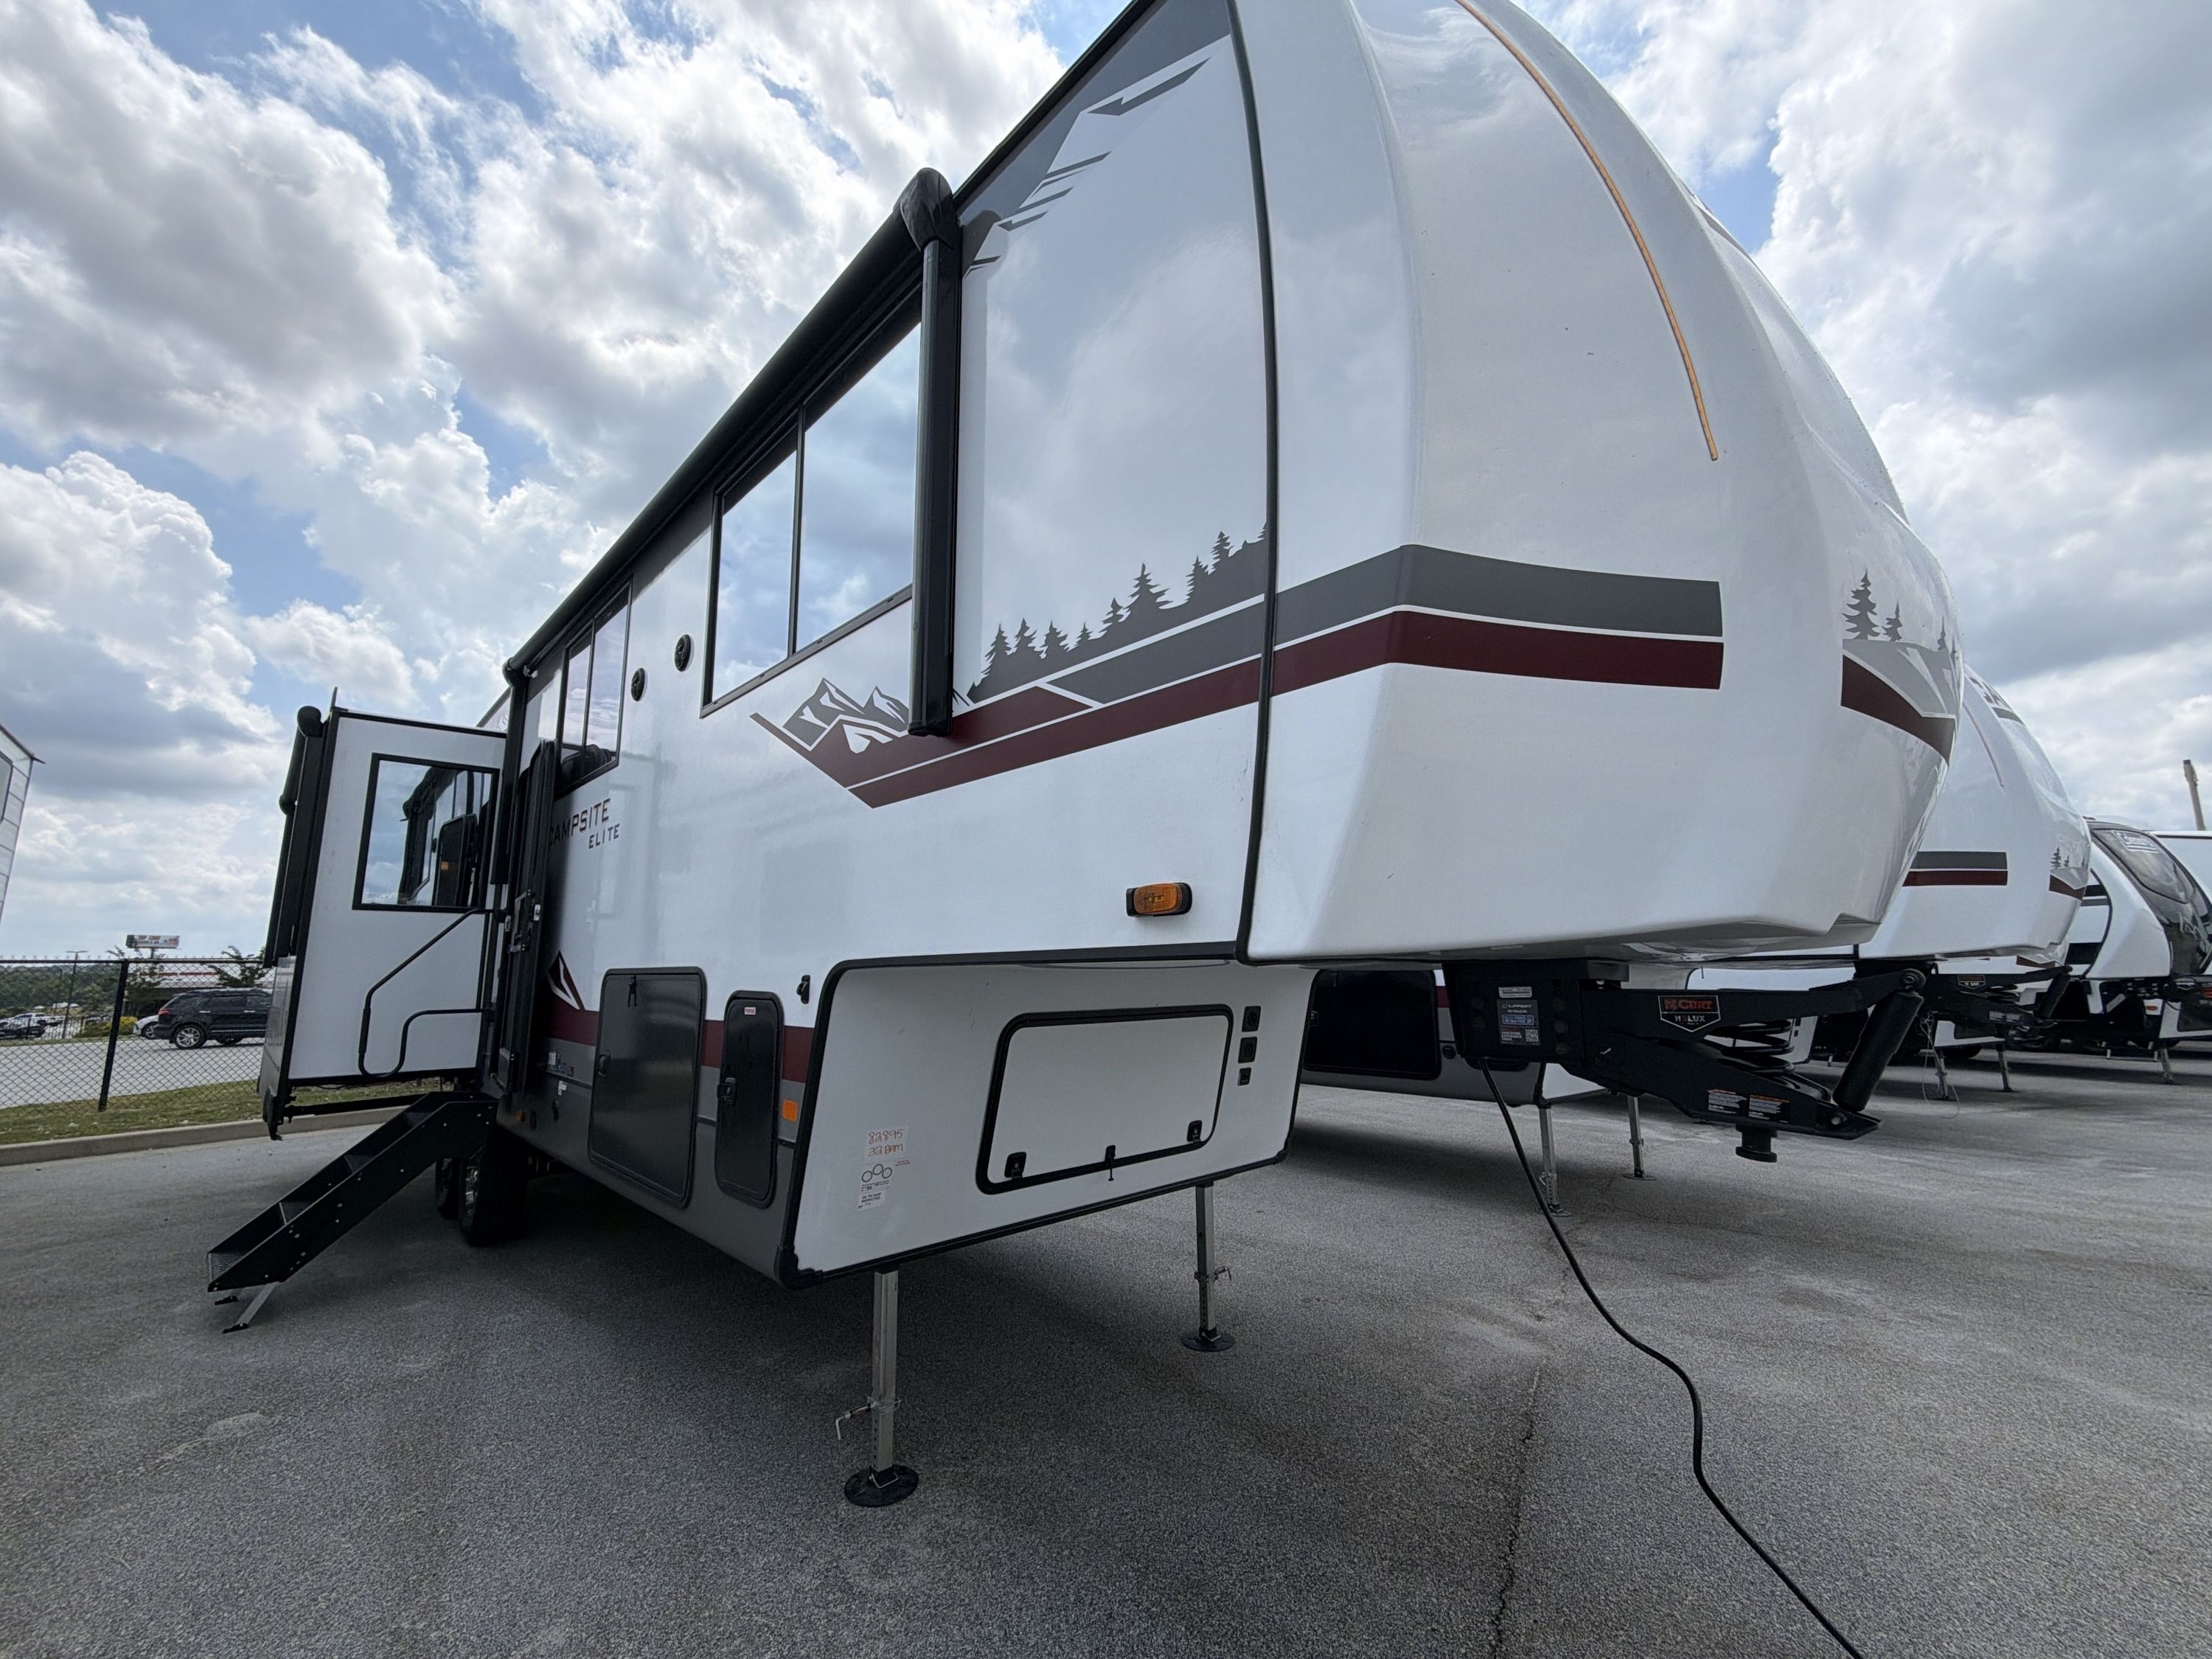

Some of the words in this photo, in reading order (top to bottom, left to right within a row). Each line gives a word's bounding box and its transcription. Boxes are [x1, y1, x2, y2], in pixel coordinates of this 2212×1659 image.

[588, 823, 620, 849] ELITE
[1677, 999, 1712, 1009] CURT
[868, 1129, 903, 1144] 82895
